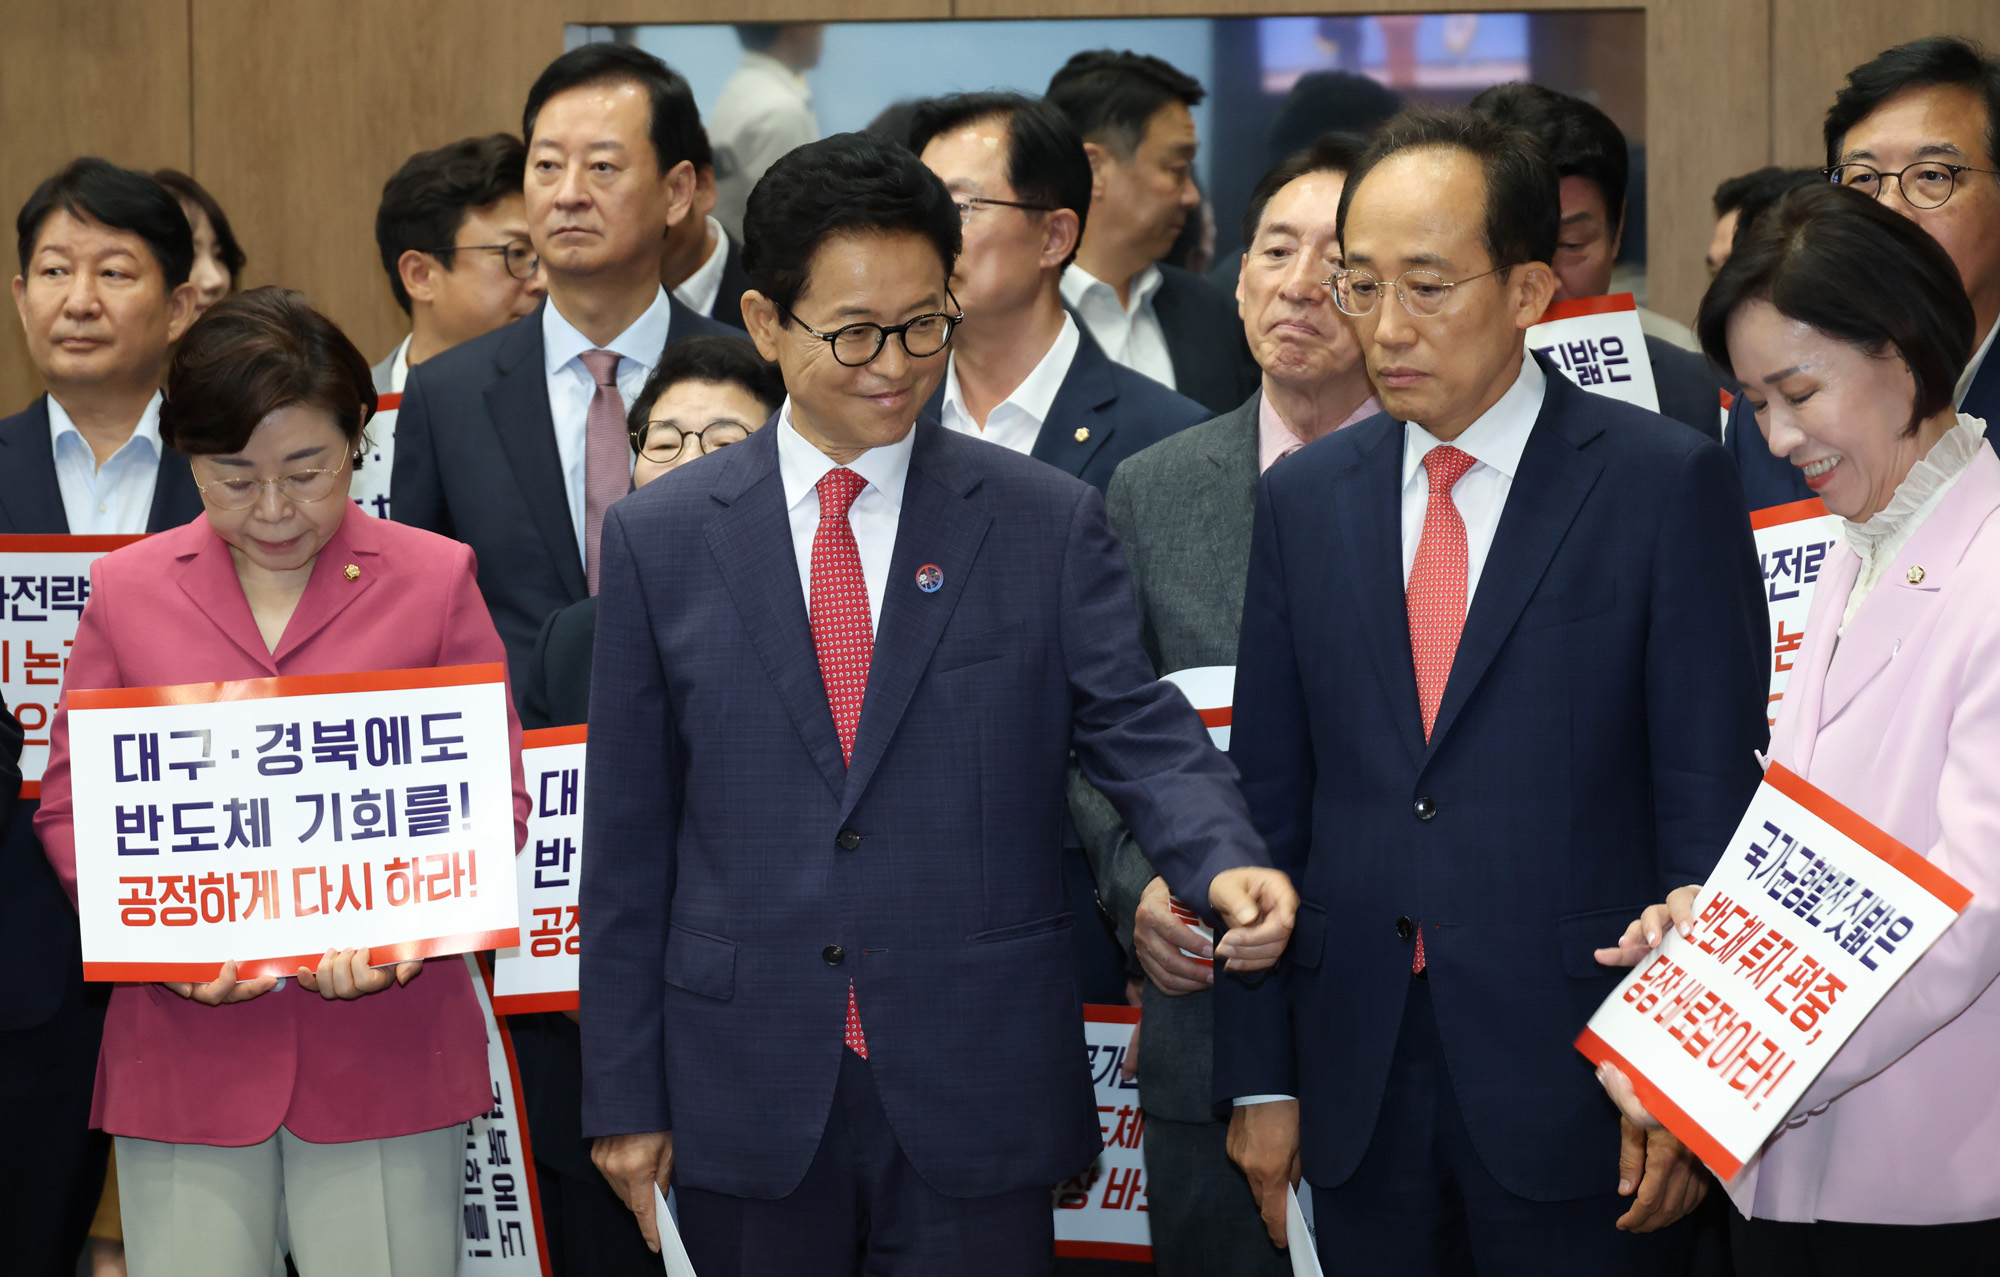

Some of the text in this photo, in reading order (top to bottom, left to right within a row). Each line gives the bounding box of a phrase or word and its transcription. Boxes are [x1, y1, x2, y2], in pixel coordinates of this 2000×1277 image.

[115, 797, 271, 856] 반도체
[295, 781, 471, 844] 기회를!
[118, 849, 478, 927] 공정하게 다시 하라!
[1744, 820, 1914, 971] 국가균형발전 짓밟은
[1684, 891, 1848, 1046] 반도체 투자 편중,
[1622, 954, 1797, 1111] 당장 바로잡아라!
